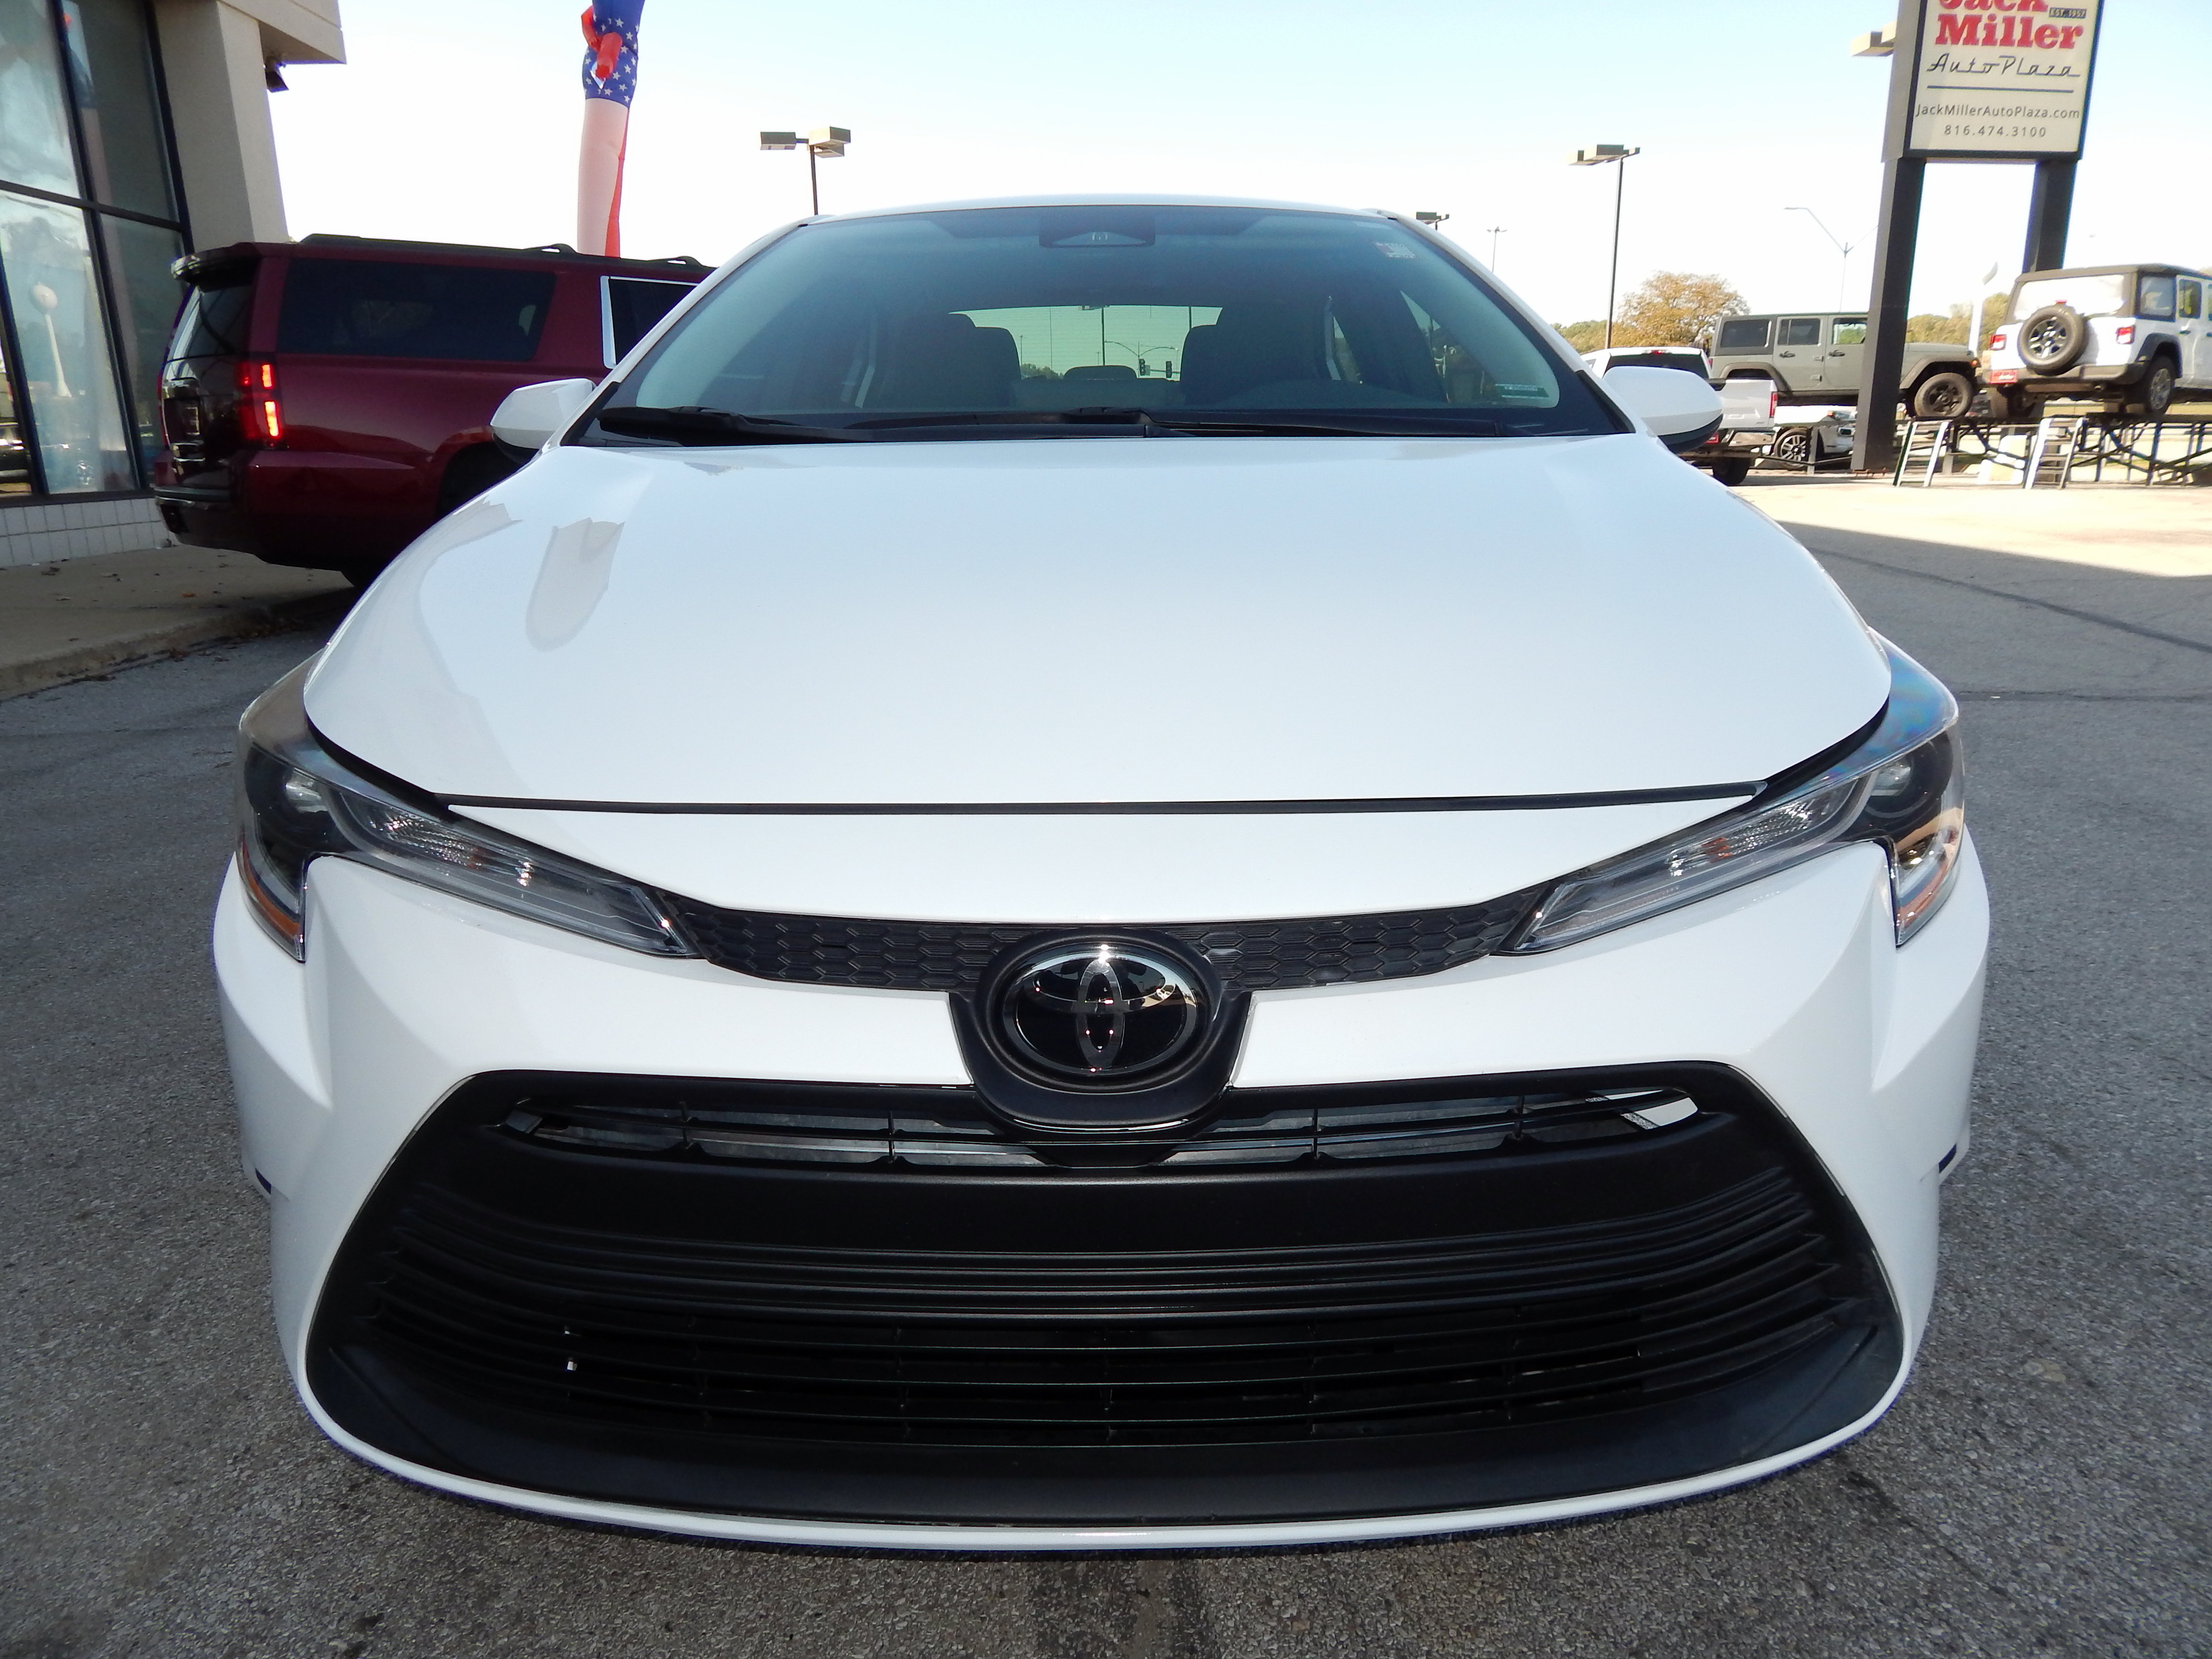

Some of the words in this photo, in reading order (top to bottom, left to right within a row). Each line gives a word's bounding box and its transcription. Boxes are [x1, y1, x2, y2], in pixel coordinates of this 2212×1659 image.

[1935, 13, 2084, 48] Miller
[1916, 104, 2079, 119] JackMillerAutoPlaza.com
[1944, 124, 2046, 137] 816.474.3100
